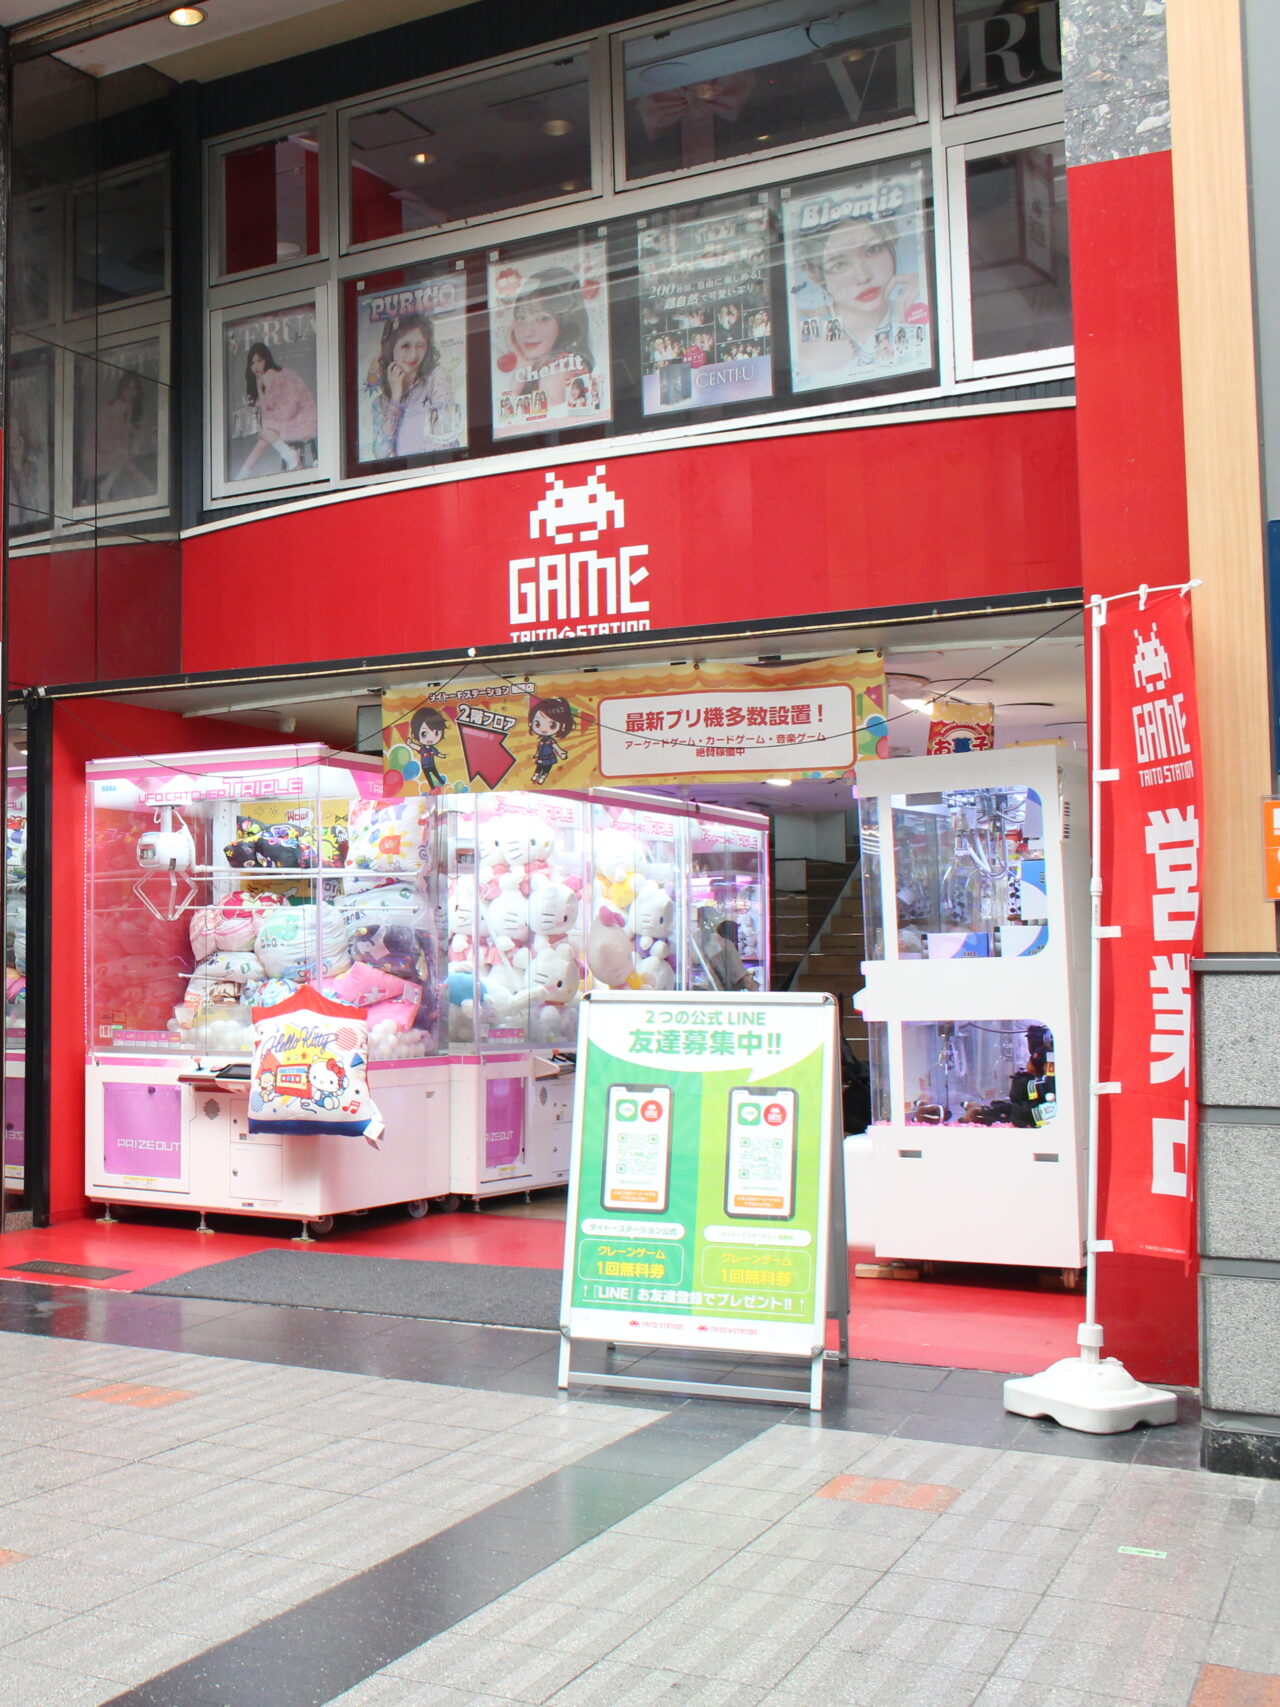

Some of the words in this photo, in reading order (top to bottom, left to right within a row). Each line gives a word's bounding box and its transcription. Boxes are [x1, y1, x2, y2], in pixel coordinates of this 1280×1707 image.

[801, 186, 904, 229] Bloomit
[515, 353, 585, 383] Cherrit
[509, 544, 650, 625] GAME
[458, 703, 517, 731] 2階フロア
[625, 704, 823, 732] 最新プリ機多数設置！
[1132, 693, 1191, 764] GAME
[223, 777, 303, 798] TRIPLE
[645, 1010, 723, 1026] 2つの公式
[728, 1011, 766, 1026] LINE
[262, 1034, 301, 1059] Hello
[300, 1026, 338, 1054] Kitty
[597, 1245, 666, 1260] クレーンゲーム
[722, 1253, 793, 1267] クレーンゲーム
[596, 1261, 665, 1279] 1回無料券
[721, 1268, 793, 1287] 1回無料券
